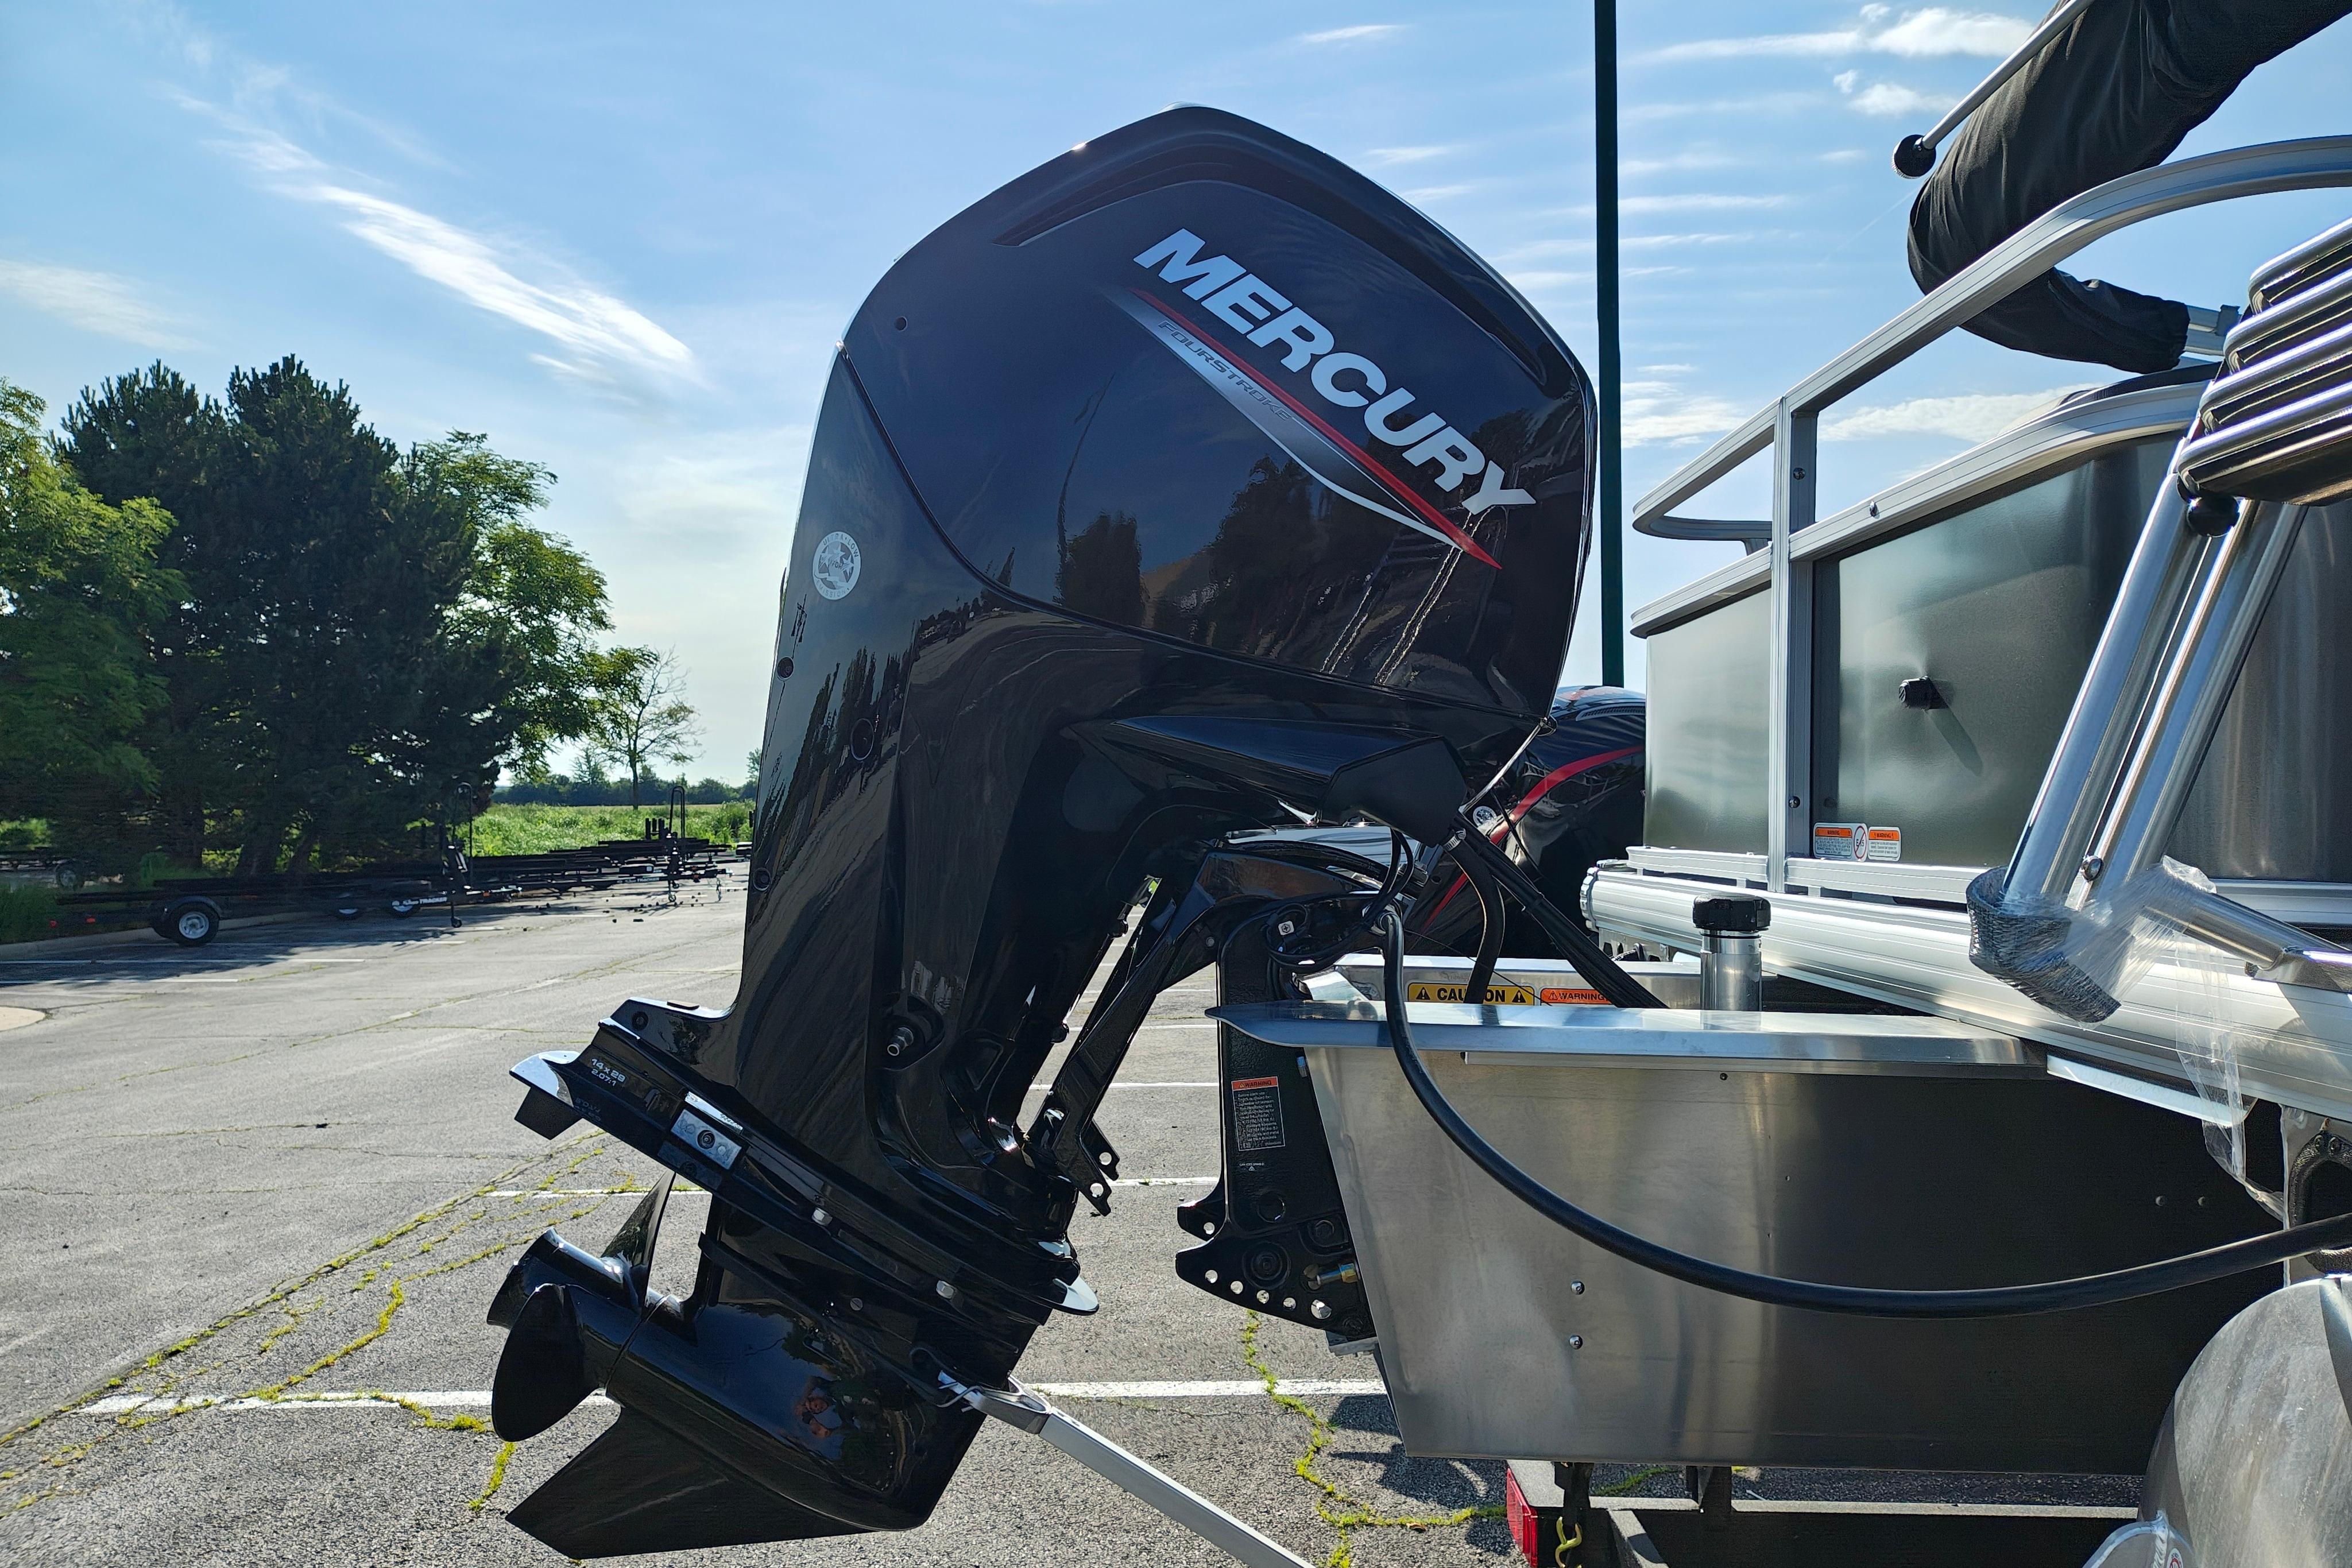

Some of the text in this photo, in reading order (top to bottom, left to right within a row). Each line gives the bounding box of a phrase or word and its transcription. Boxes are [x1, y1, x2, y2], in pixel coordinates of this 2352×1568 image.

[1132, 227, 1537, 515] MERCURY
[1158, 320, 1291, 421] FOURSTROKE
[1437, 988, 1506, 1002] CAUON
[1559, 992, 1604, 1001] WARNING
[591, 1068, 617, 1086] 2.07:1
